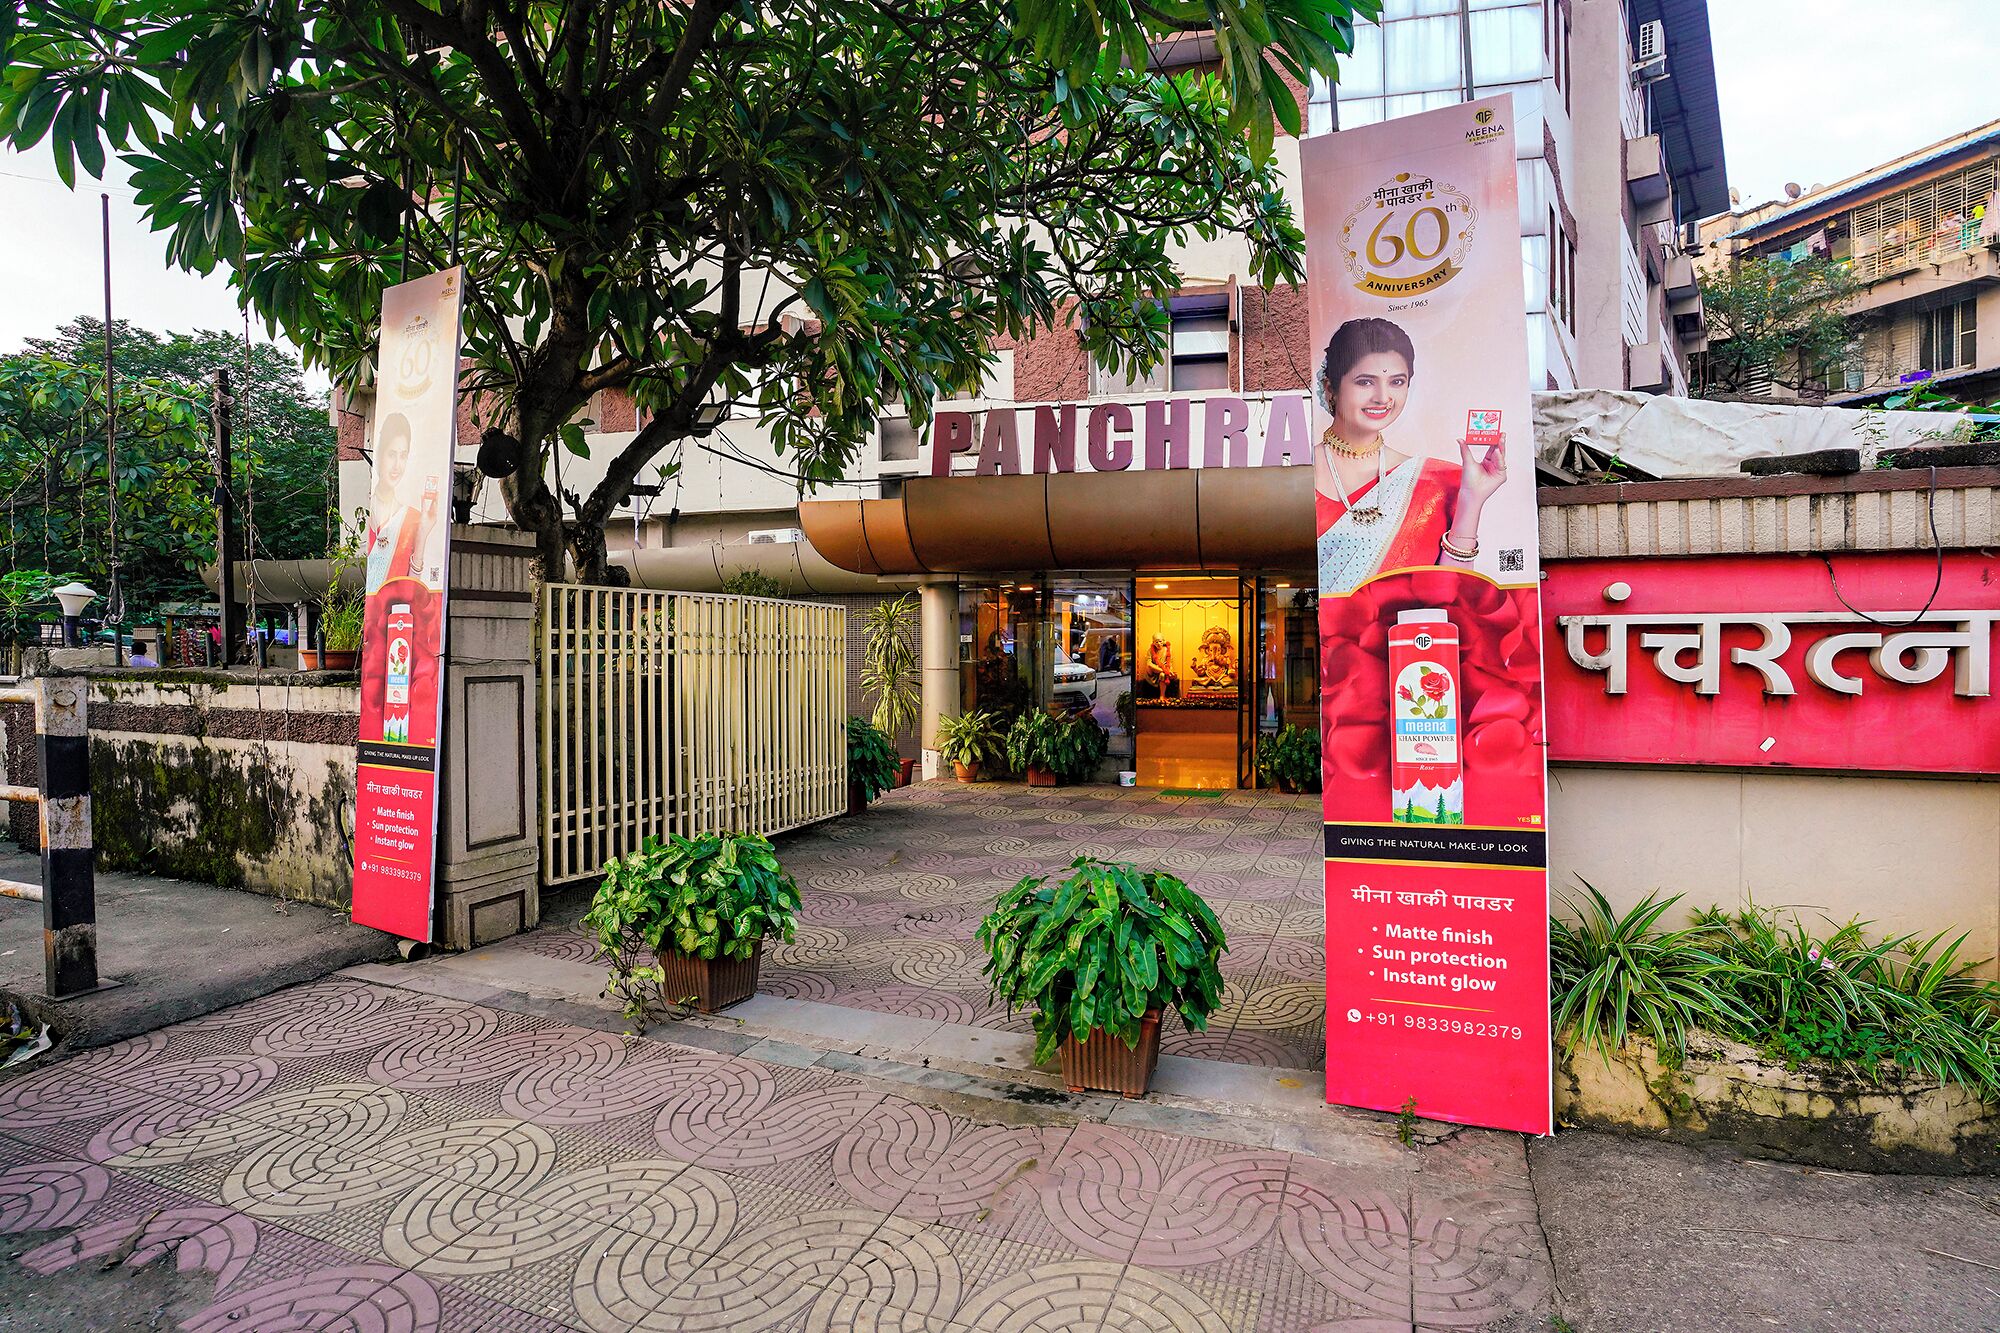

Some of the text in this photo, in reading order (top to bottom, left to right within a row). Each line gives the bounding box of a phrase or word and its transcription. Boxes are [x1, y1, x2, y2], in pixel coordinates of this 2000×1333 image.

[1465, 124, 1505, 139] MEENA
[1373, 178, 1433, 200] मीना खाकी
[1386, 192, 1423, 207] पावडर
[1366, 269, 1448, 292] ANNIVERSARY
[1387, 299, 1429, 313] Since 1965
[931, 395, 1313, 477] PANCHRA
[1556, 581, 2000, 697] पंचरत्न
[1405, 721, 1447, 732] meena
[366, 781, 423, 799] मीना खाकी पावडर
[377, 806, 415, 821] Matte finish
[372, 820, 419, 836] Sun protection
[374, 835, 414, 851] Instant glow
[1340, 837, 1528, 853] GIVING THE NATURAL MAKE-UP LOOK
[368, 864, 422, 882] +91 9833982379
[1351, 884, 1515, 912] मीना खाकी पावडर
[1385, 923, 1493, 945] Matte finish
[1372, 945, 1507, 970] Sun protection
[1383, 967, 1496, 992] Instant glow
[1366, 1013, 1523, 1040] +91 9833982379
